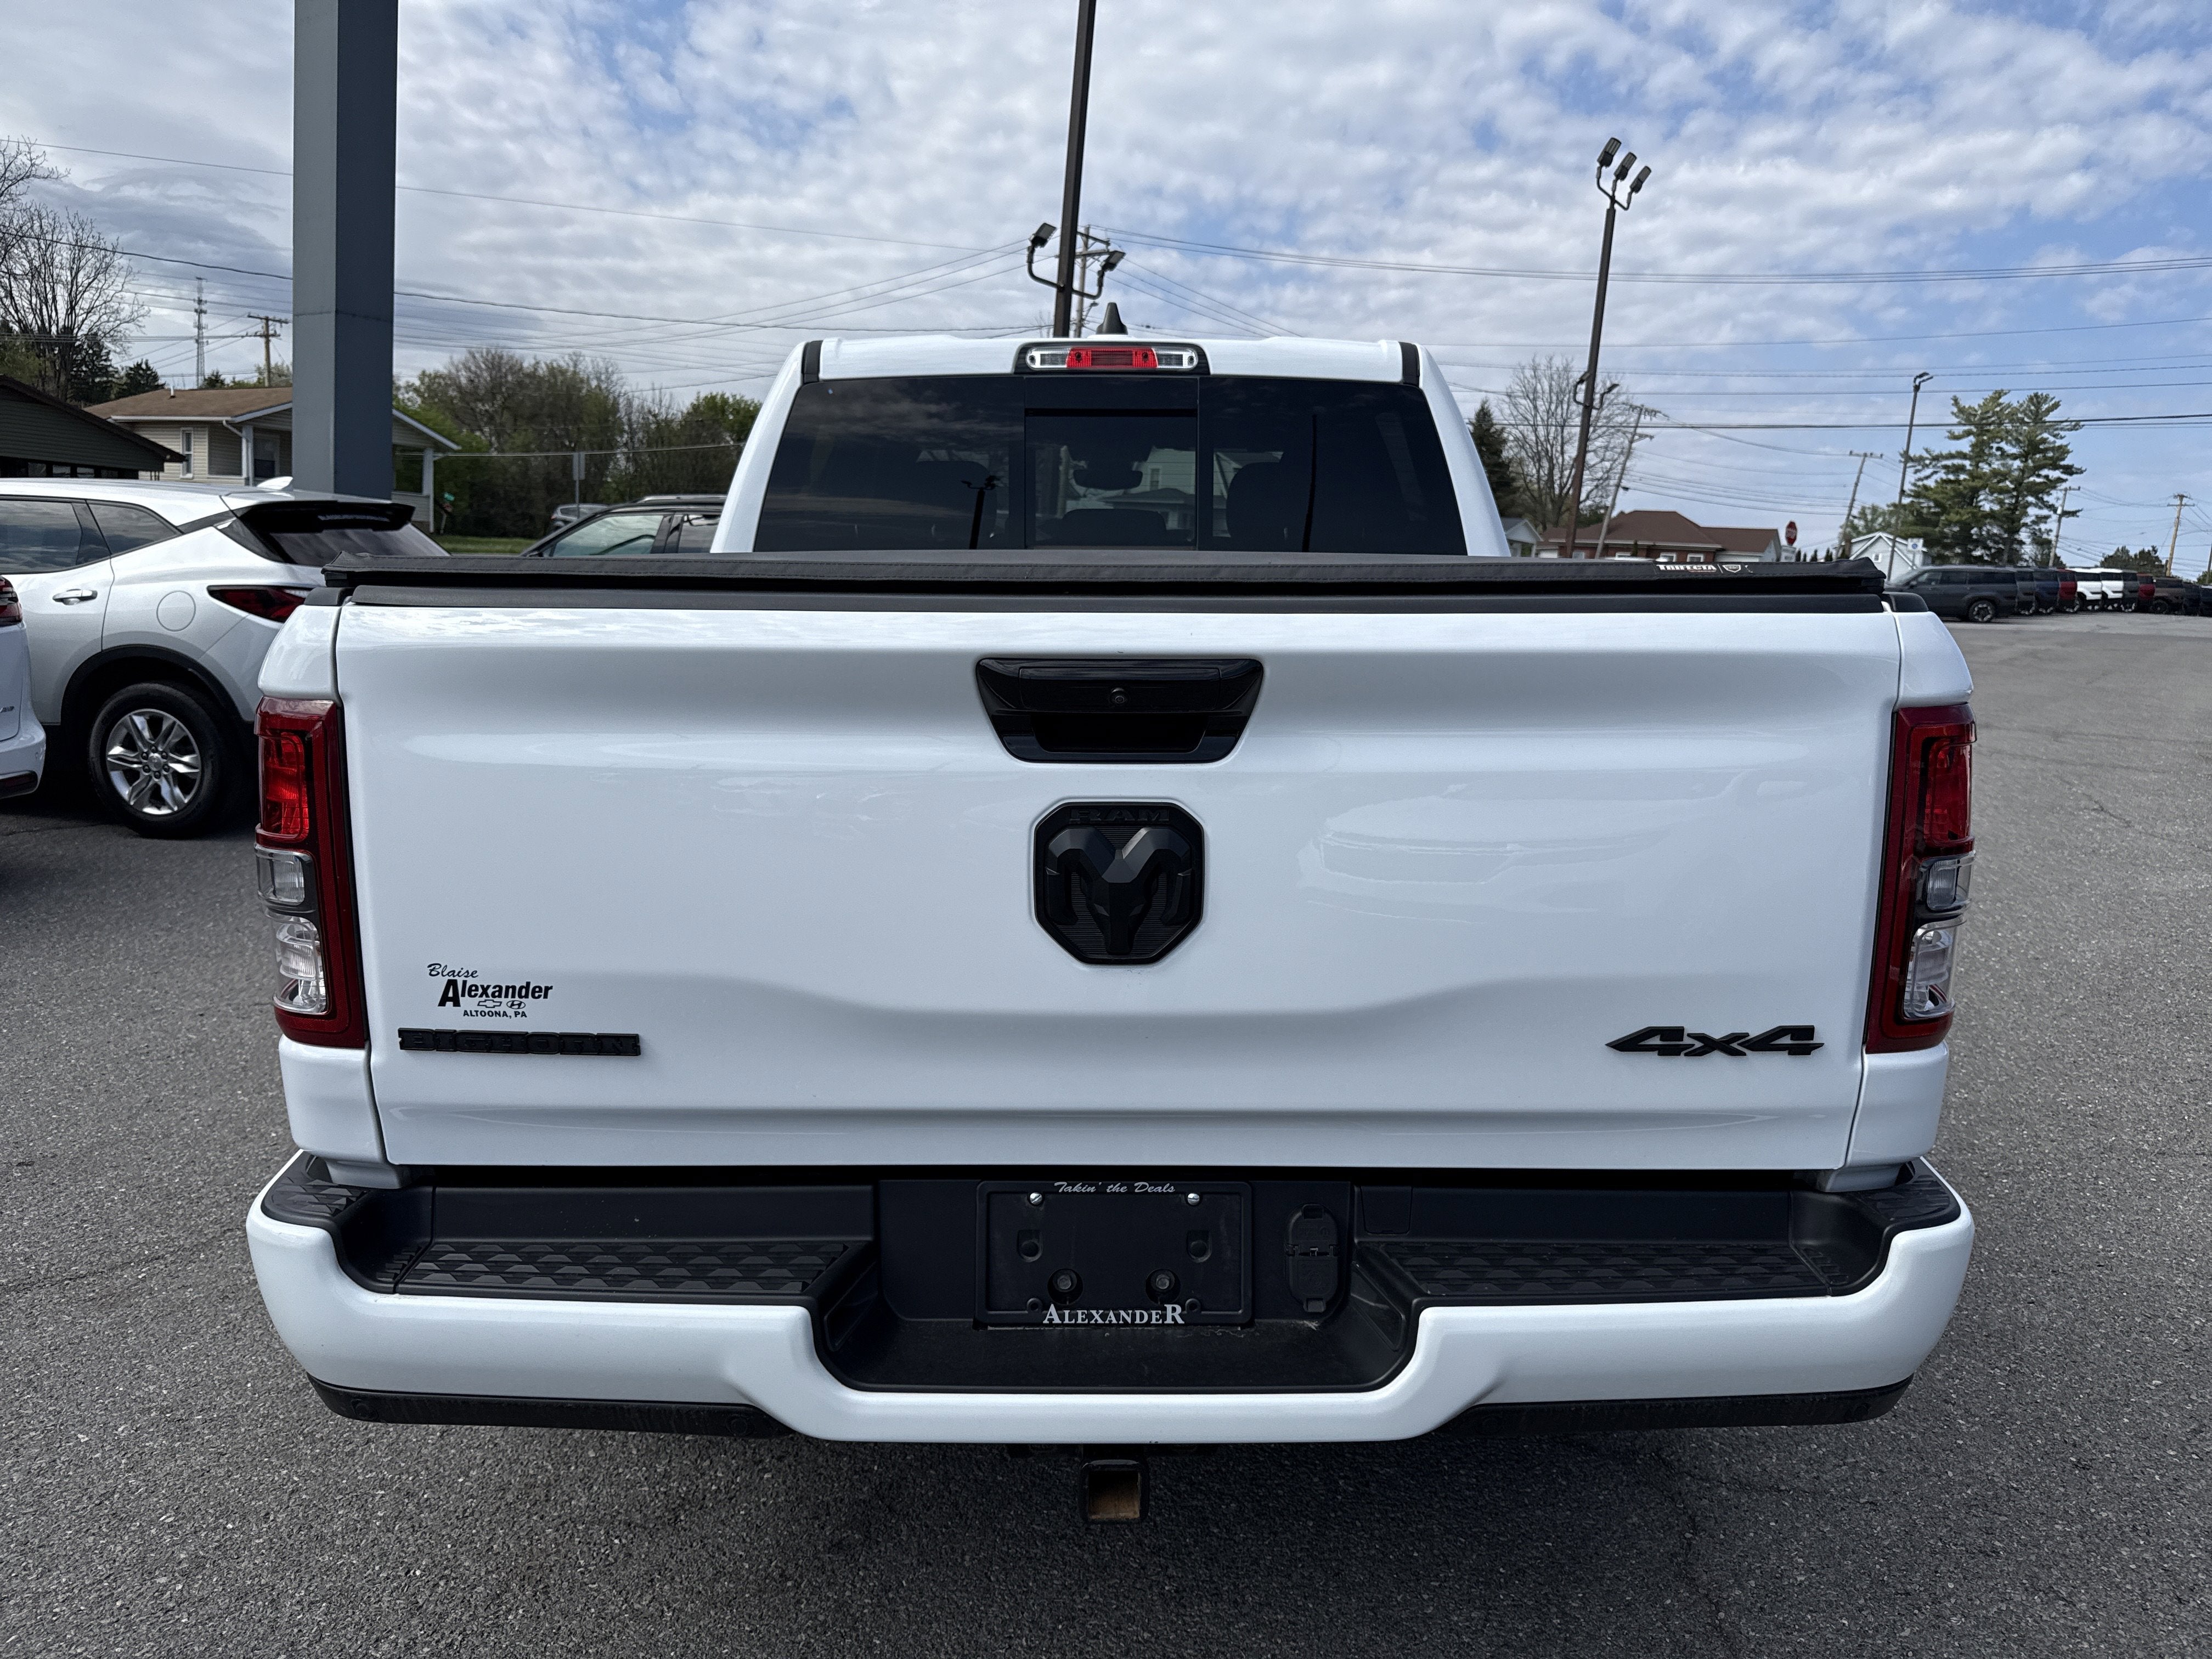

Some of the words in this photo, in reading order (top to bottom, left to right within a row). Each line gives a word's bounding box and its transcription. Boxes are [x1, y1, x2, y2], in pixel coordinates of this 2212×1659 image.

[1070, 809, 1170, 821] RAM
[427, 963, 479, 978] Blaise
[437, 979, 553, 1007] Alexander
[462, 1009, 512, 1019] ALTOONA,
[1605, 1025, 1825, 1057] 4x4
[1053, 1181, 1102, 1193] Takin'
[1106, 1183, 1127, 1193] the
[1133, 1181, 1176, 1193] Deals
[1043, 1304, 1184, 1324] ALEXANDER
